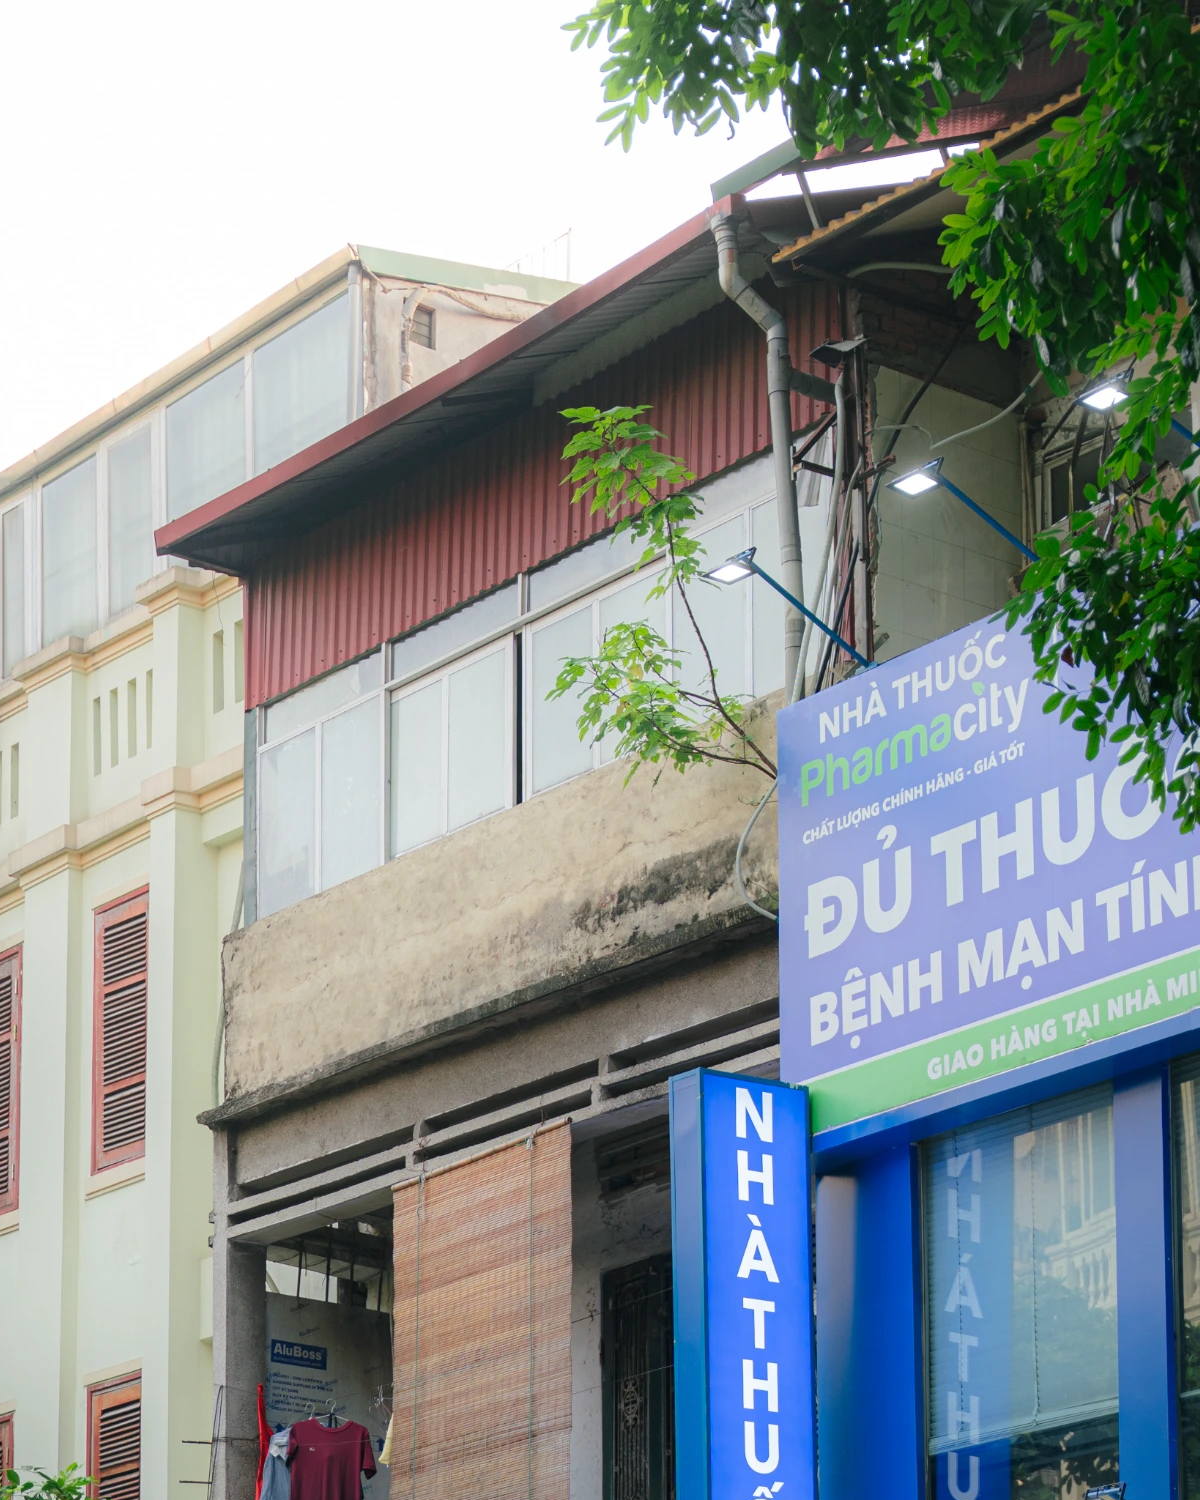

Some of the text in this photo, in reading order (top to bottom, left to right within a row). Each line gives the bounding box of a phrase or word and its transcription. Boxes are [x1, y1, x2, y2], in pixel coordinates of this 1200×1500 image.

[801, 678, 1029, 807] Pharmacity
[819, 631, 1007, 743] NHÀ THUỐC
[803, 742, 1025, 845] CHẤT LƯỢNG CHÍNH HÃNG GIÁ TỐT
[805, 728, 1200, 958] ĐỦ THUỐ
[810, 859, 1200, 1049] BỆNH MẠN TÍN
[927, 1044, 984, 1080] GIAO
[991, 1017, 1057, 1063] HÀNG
[1062, 1004, 1099, 1037] TẠI
[1108, 979, 1161, 1021] NHÀ
[735, 1087, 780, 1284] NHÀ
[274, 1343, 322, 1361] AluBoss
